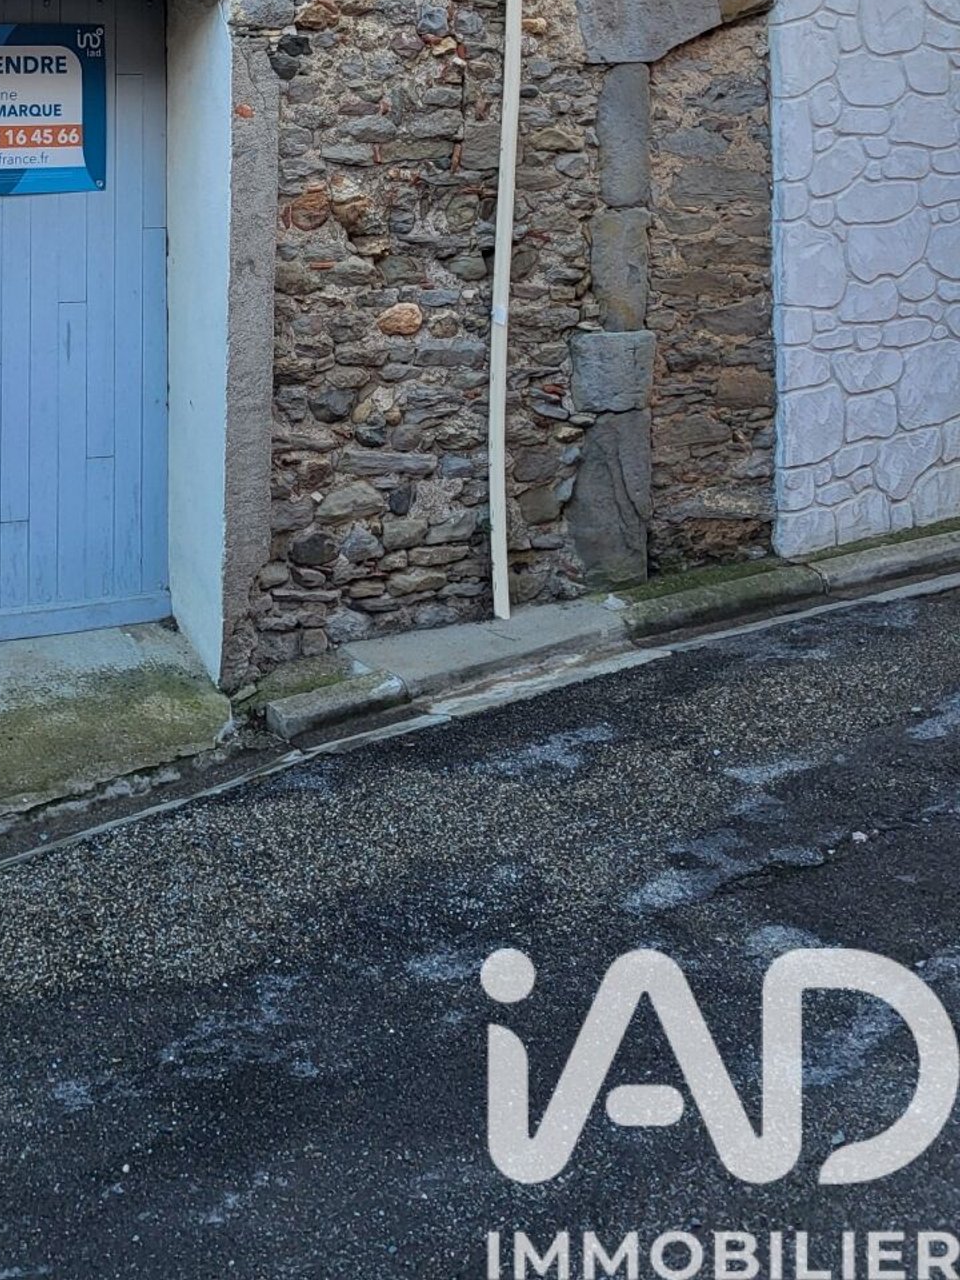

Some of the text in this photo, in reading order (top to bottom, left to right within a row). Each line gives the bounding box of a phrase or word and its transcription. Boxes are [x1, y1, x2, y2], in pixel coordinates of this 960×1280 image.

[5, 129, 27, 145] 16
[31, 129, 54, 144] 45
[57, 128, 80, 143] 66
